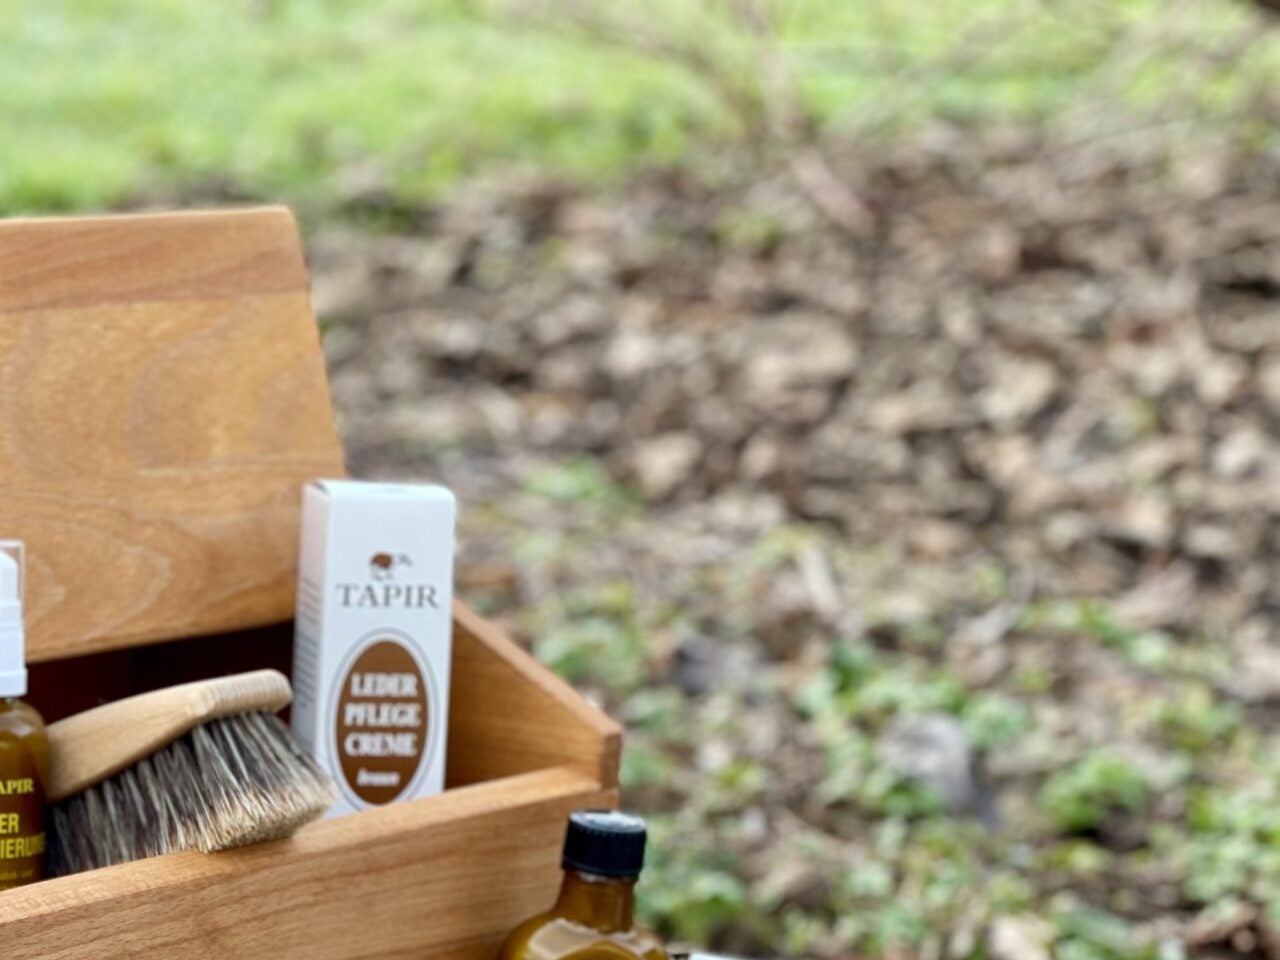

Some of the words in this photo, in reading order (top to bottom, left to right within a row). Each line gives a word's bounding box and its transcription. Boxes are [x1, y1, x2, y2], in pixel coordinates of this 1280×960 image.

[334, 583, 441, 609] TAPIR
[351, 673, 418, 698] LEDER
[344, 702, 422, 727] PFLEGE
[344, 732, 418, 757] CREME
